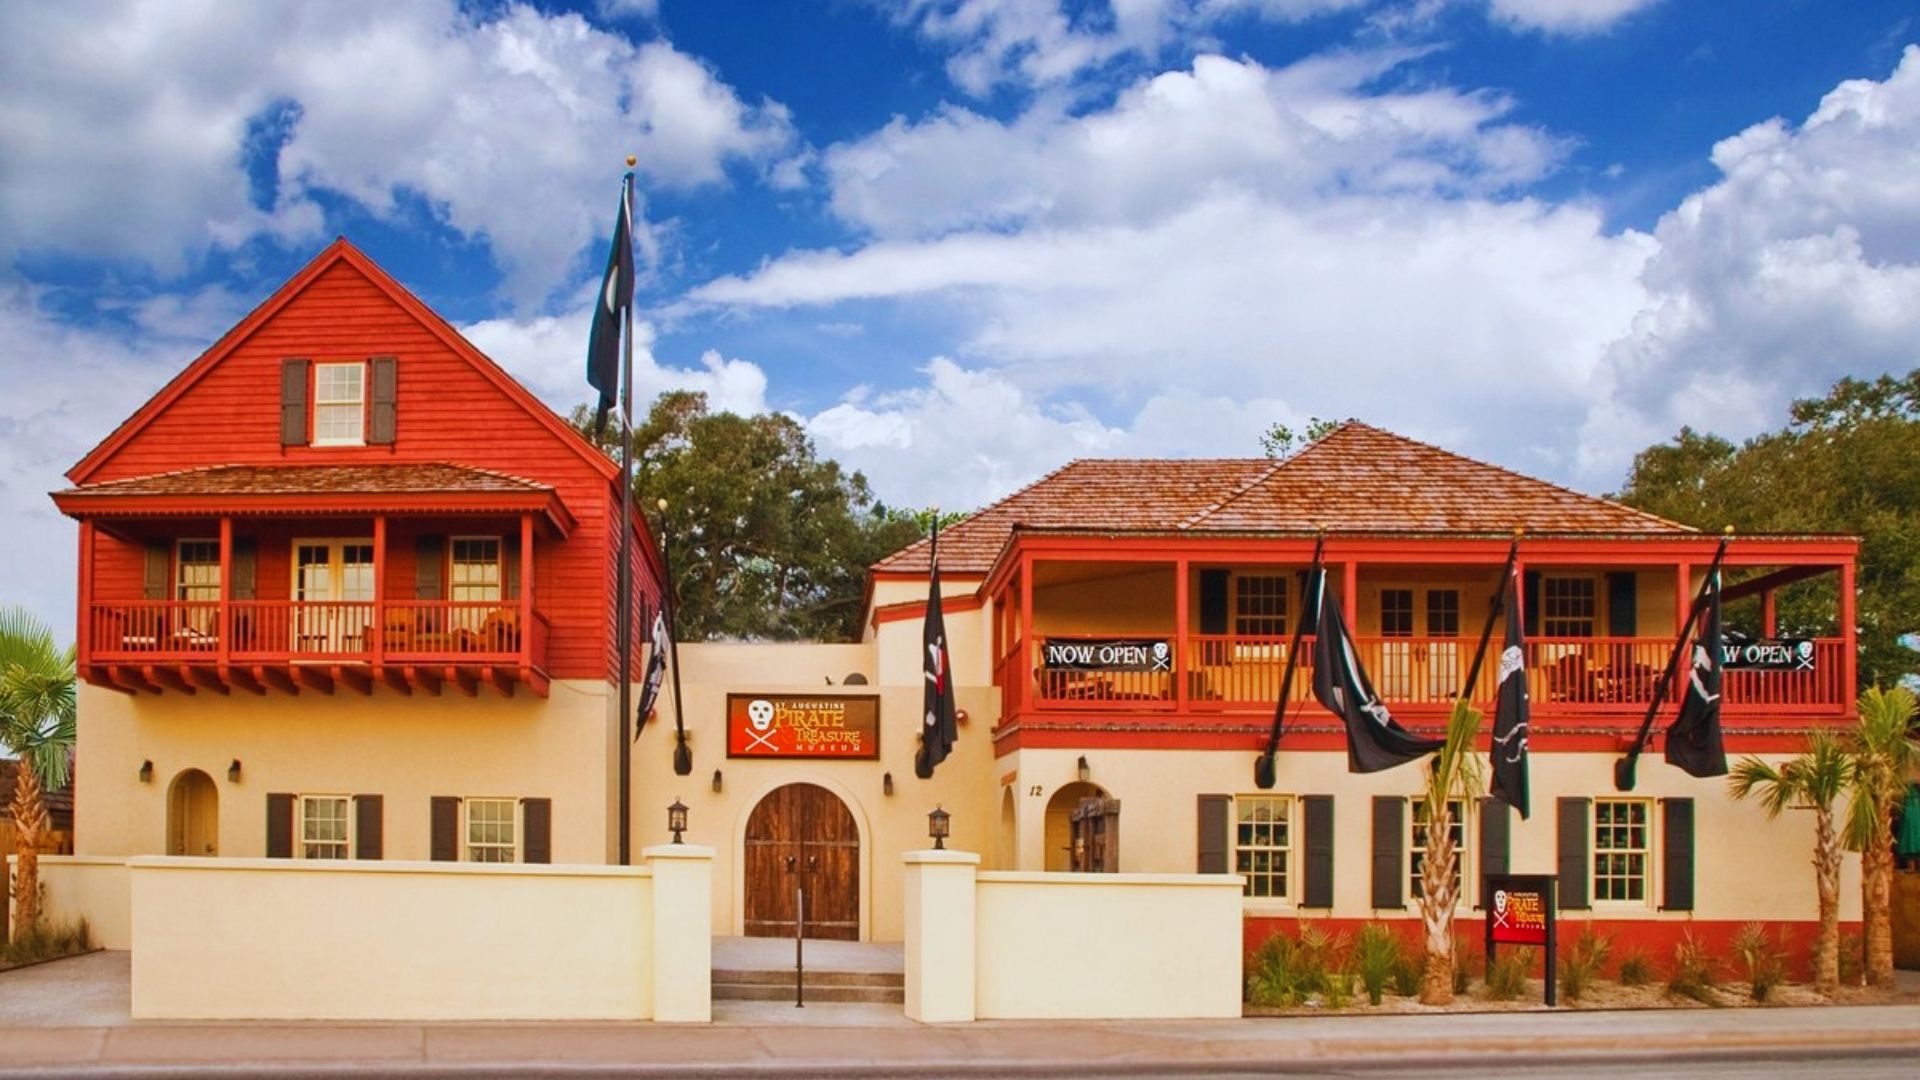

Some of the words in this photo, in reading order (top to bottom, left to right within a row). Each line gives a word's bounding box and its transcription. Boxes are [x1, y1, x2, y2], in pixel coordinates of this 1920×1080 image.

[1049, 645, 1095, 664] NOW
[1099, 645, 1147, 665] OPEN
[1745, 644, 1792, 664] OPEN
[774, 708, 844, 729] PIRATE
[793, 727, 861, 744] TREASURE
[797, 744, 860, 752] MUSEUM
[1029, 785, 1043, 797] 12
